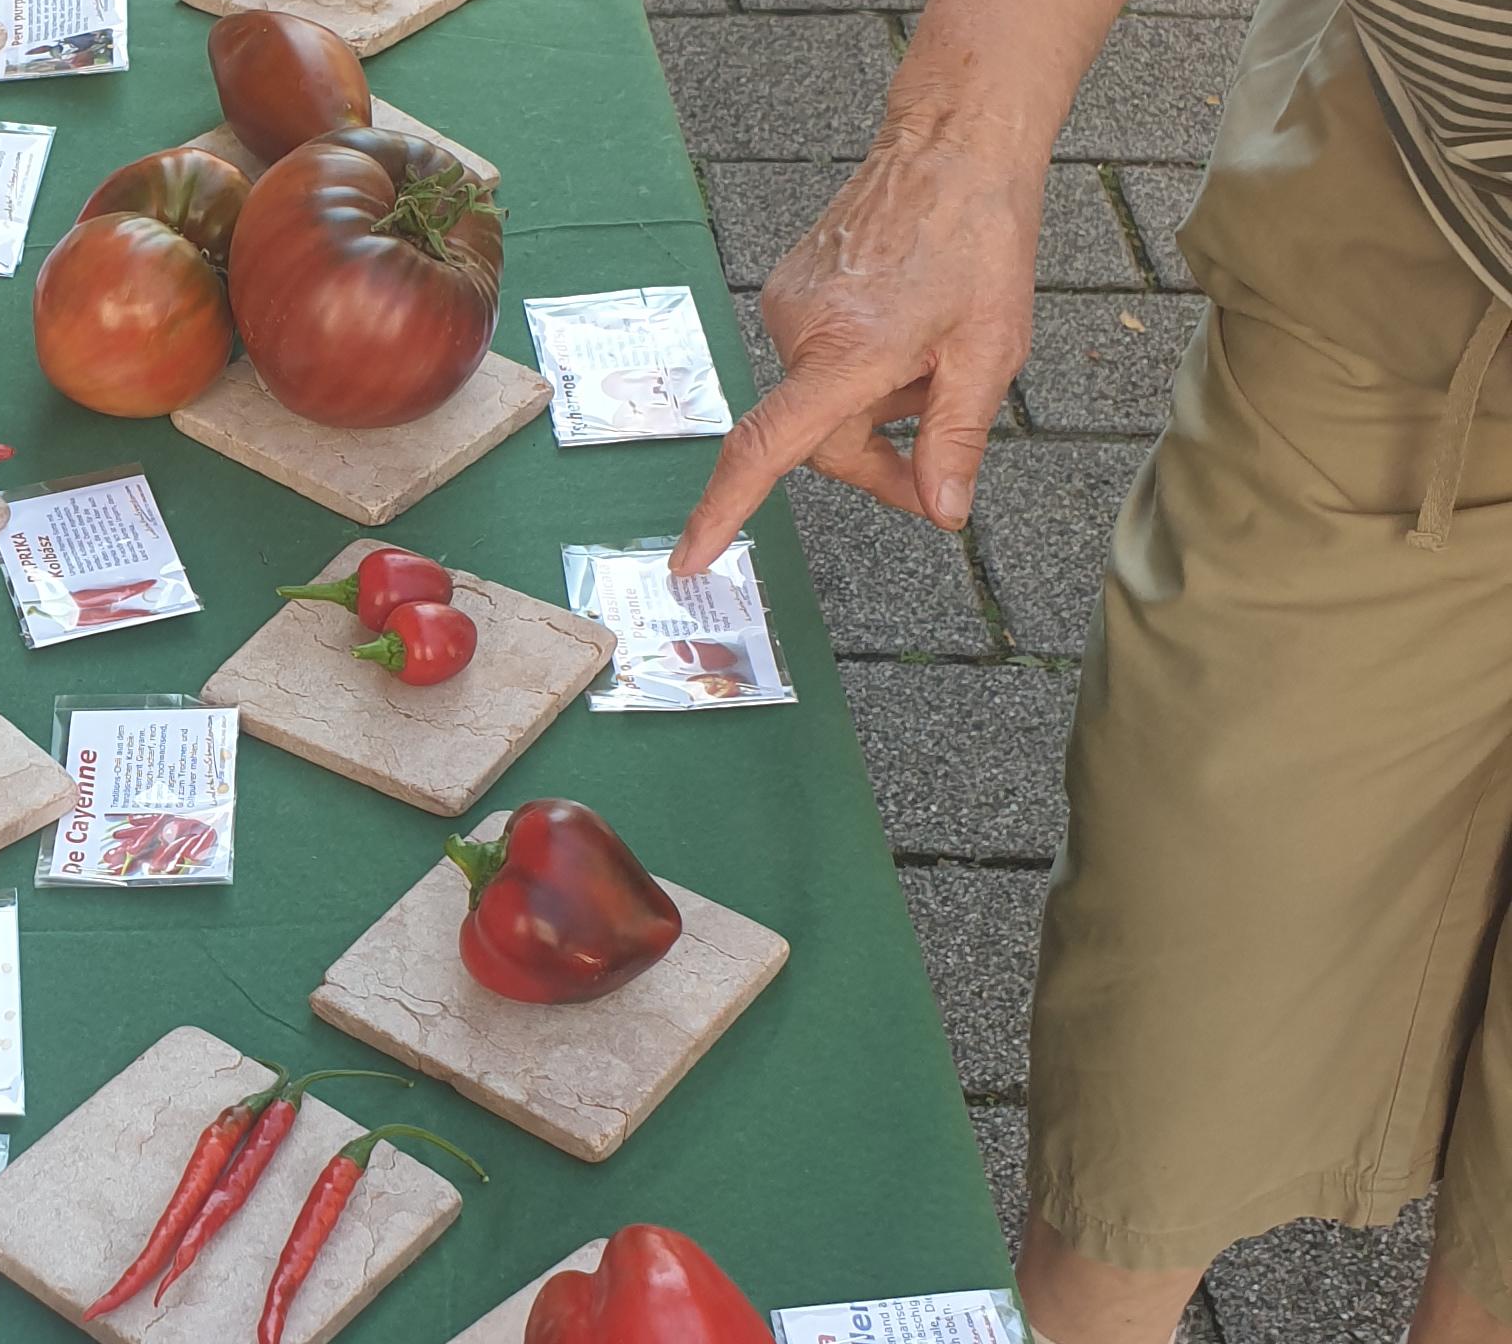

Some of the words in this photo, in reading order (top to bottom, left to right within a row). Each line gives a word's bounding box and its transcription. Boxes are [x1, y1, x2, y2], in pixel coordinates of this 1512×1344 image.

[38, 534, 64, 579] Kolbász
[66, 748, 98, 845] Cayenne
[62, 850, 80, 875] De
[943, 1304, 957, 1333] oben.
